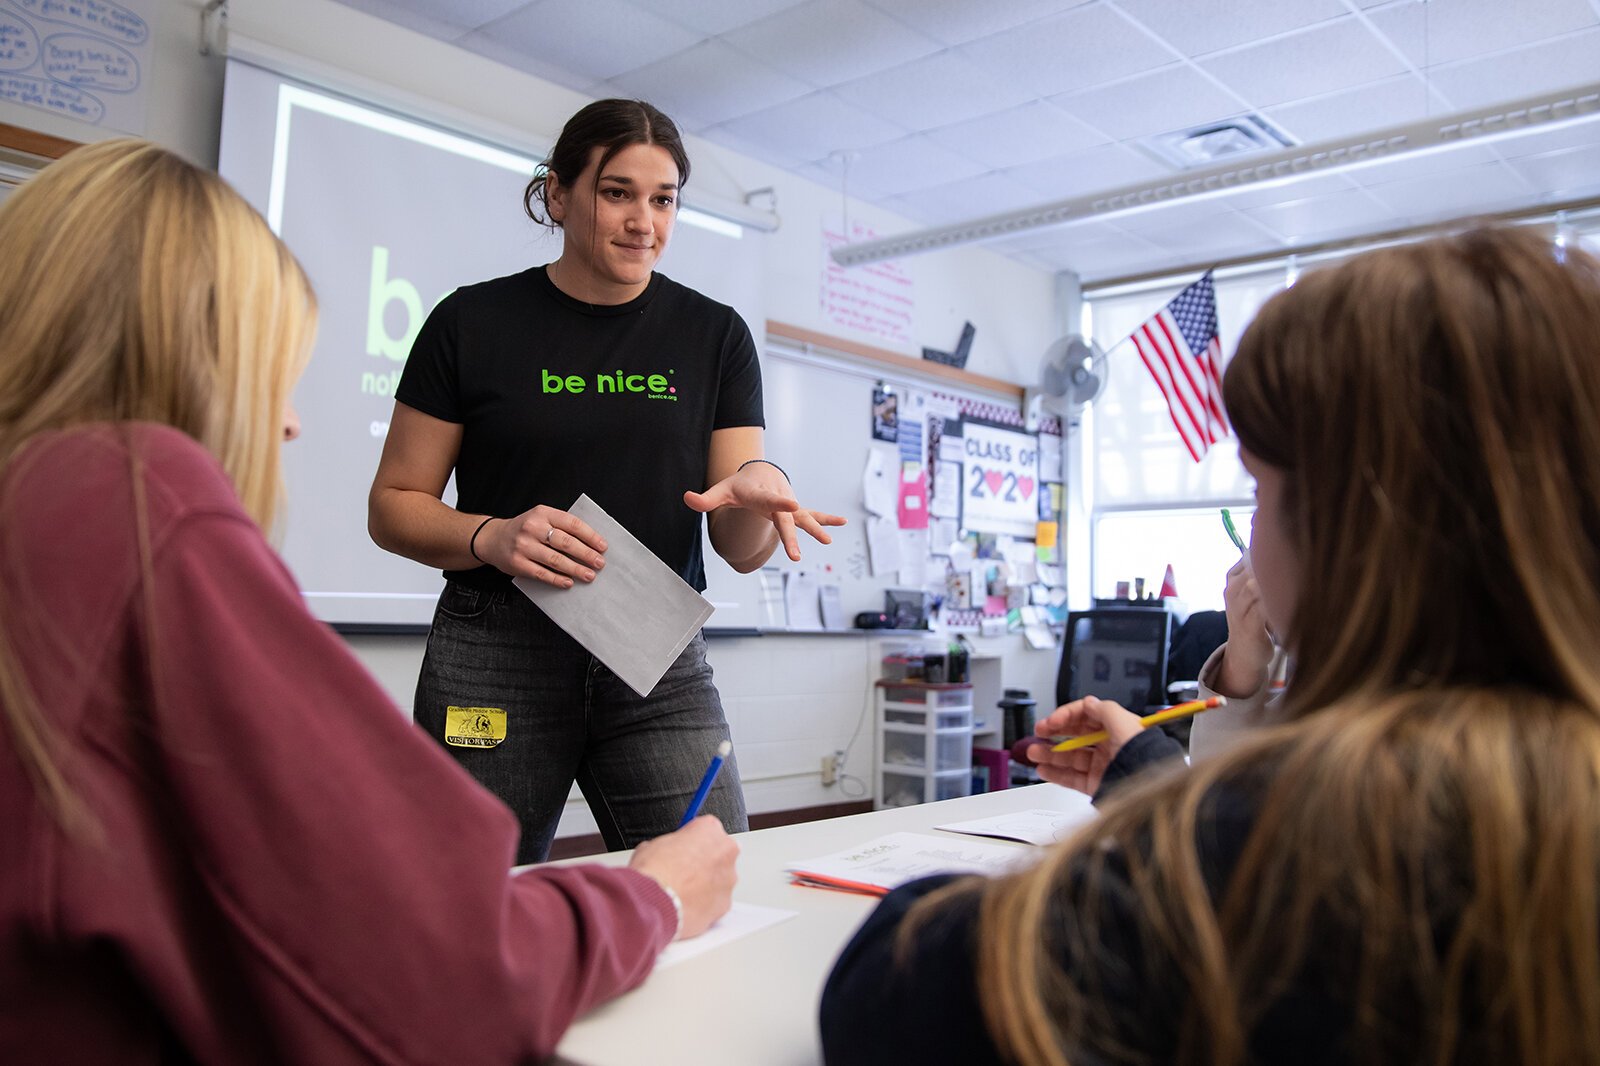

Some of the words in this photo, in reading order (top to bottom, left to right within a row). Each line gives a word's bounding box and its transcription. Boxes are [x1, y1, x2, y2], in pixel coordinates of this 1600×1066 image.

[542, 369, 586, 393] be
[648, 393, 677, 401] benice.org
[965, 438, 1012, 462] CLASS
[1019, 449, 1036, 467] OF
